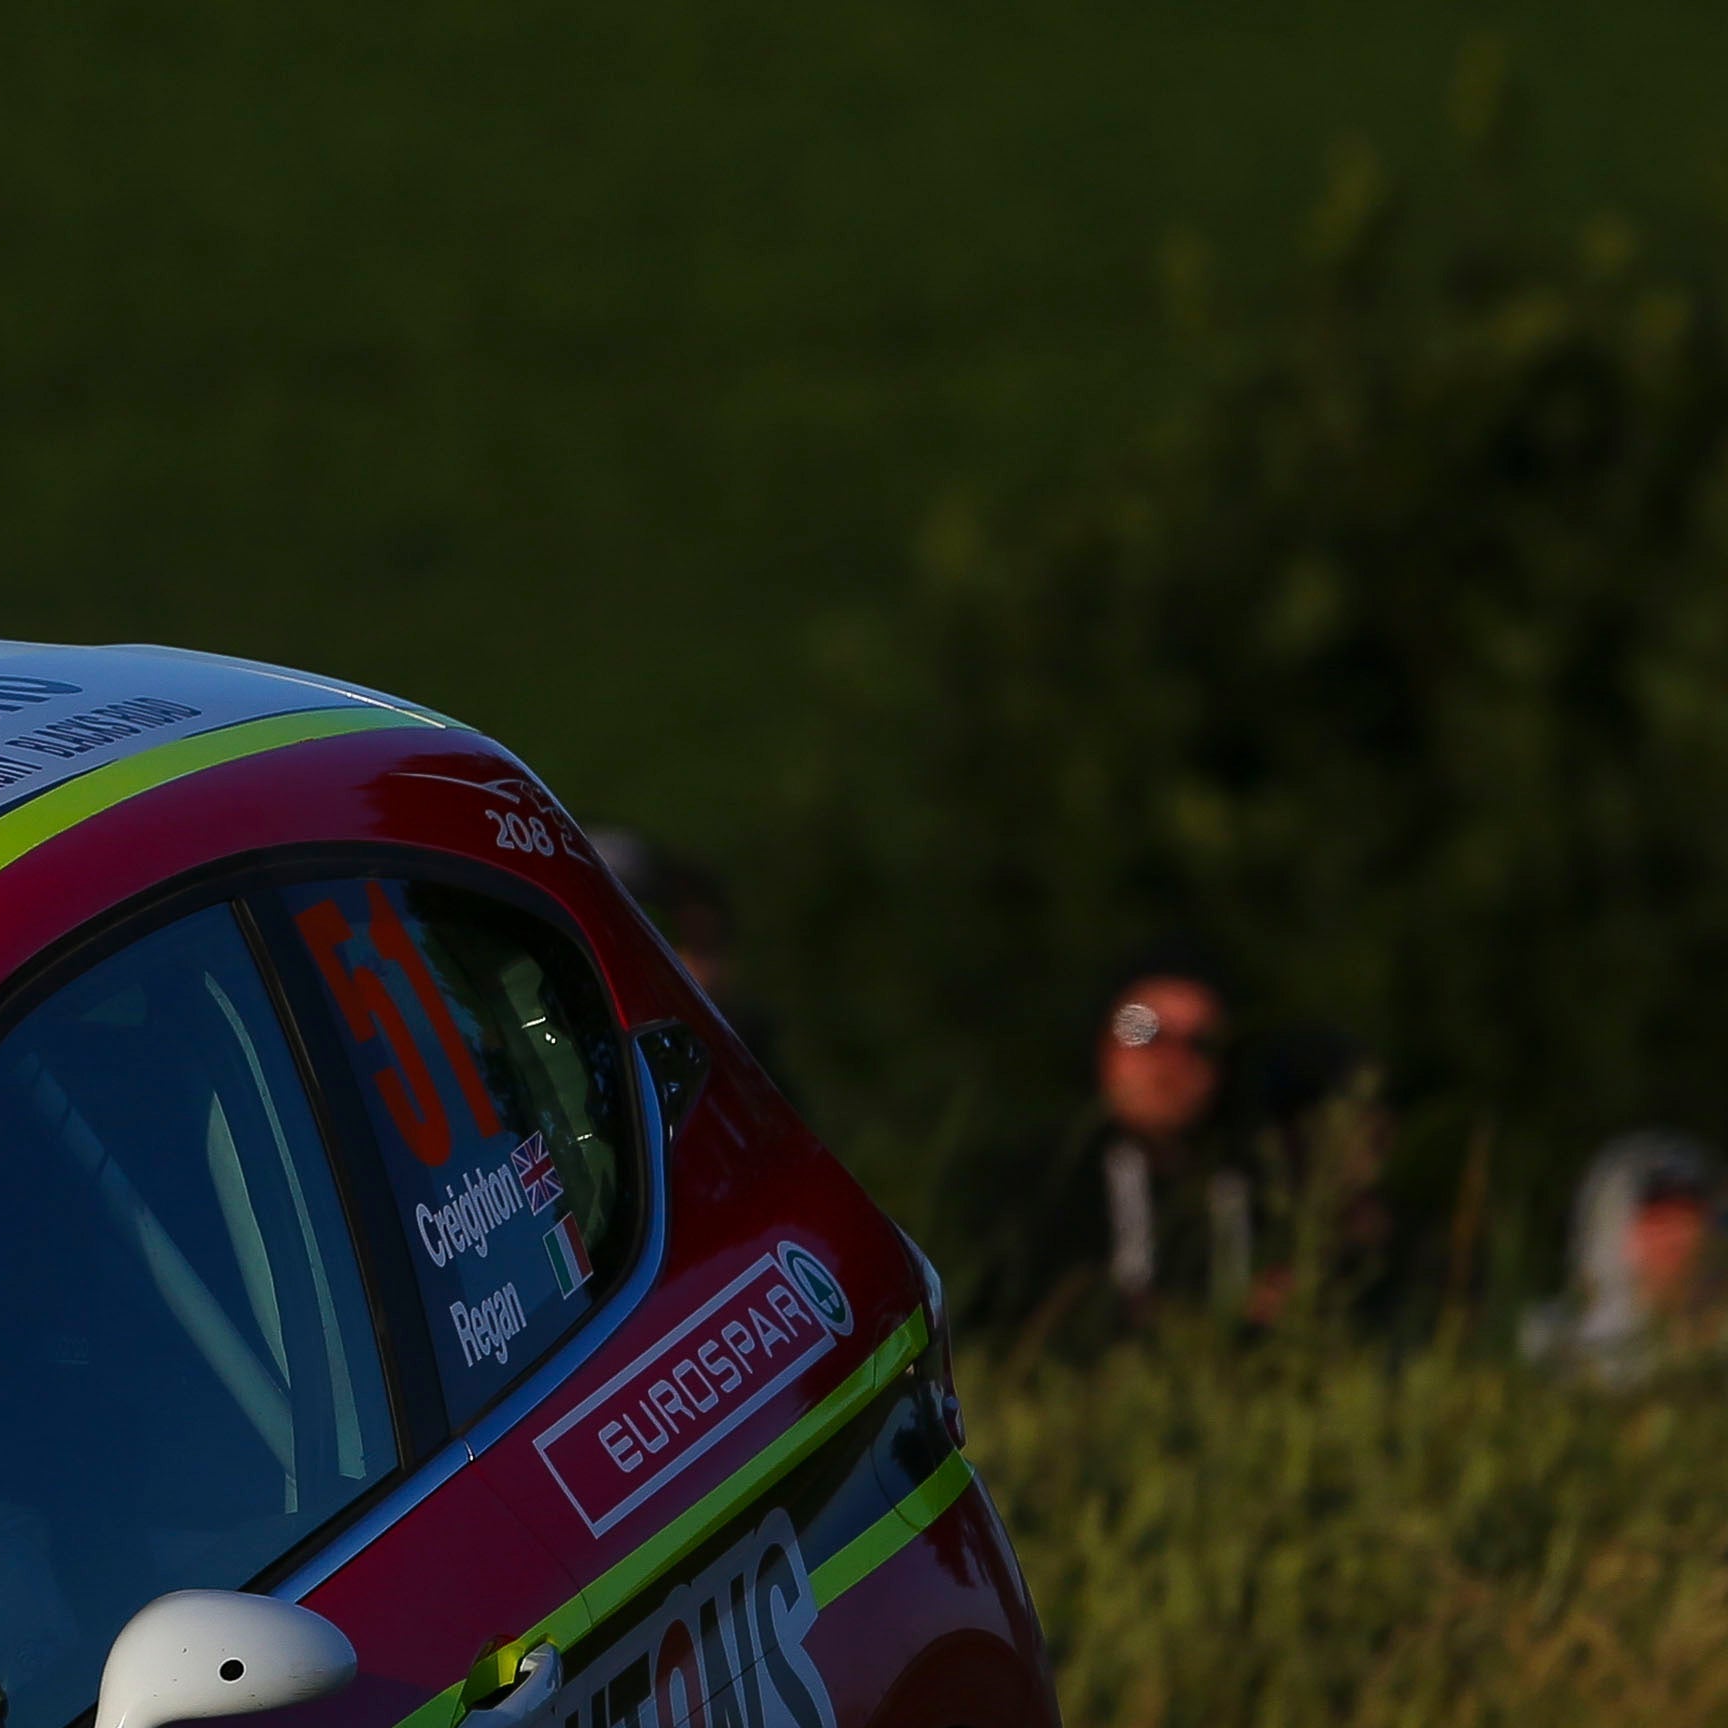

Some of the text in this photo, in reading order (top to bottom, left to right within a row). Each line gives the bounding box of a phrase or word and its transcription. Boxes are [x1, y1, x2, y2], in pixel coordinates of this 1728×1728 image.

[294, 880, 502, 1168] 51
[414, 1158, 525, 1270] Creighton
[449, 1278, 528, 1368] Regan
[596, 1284, 812, 1474] EUROSPAR
